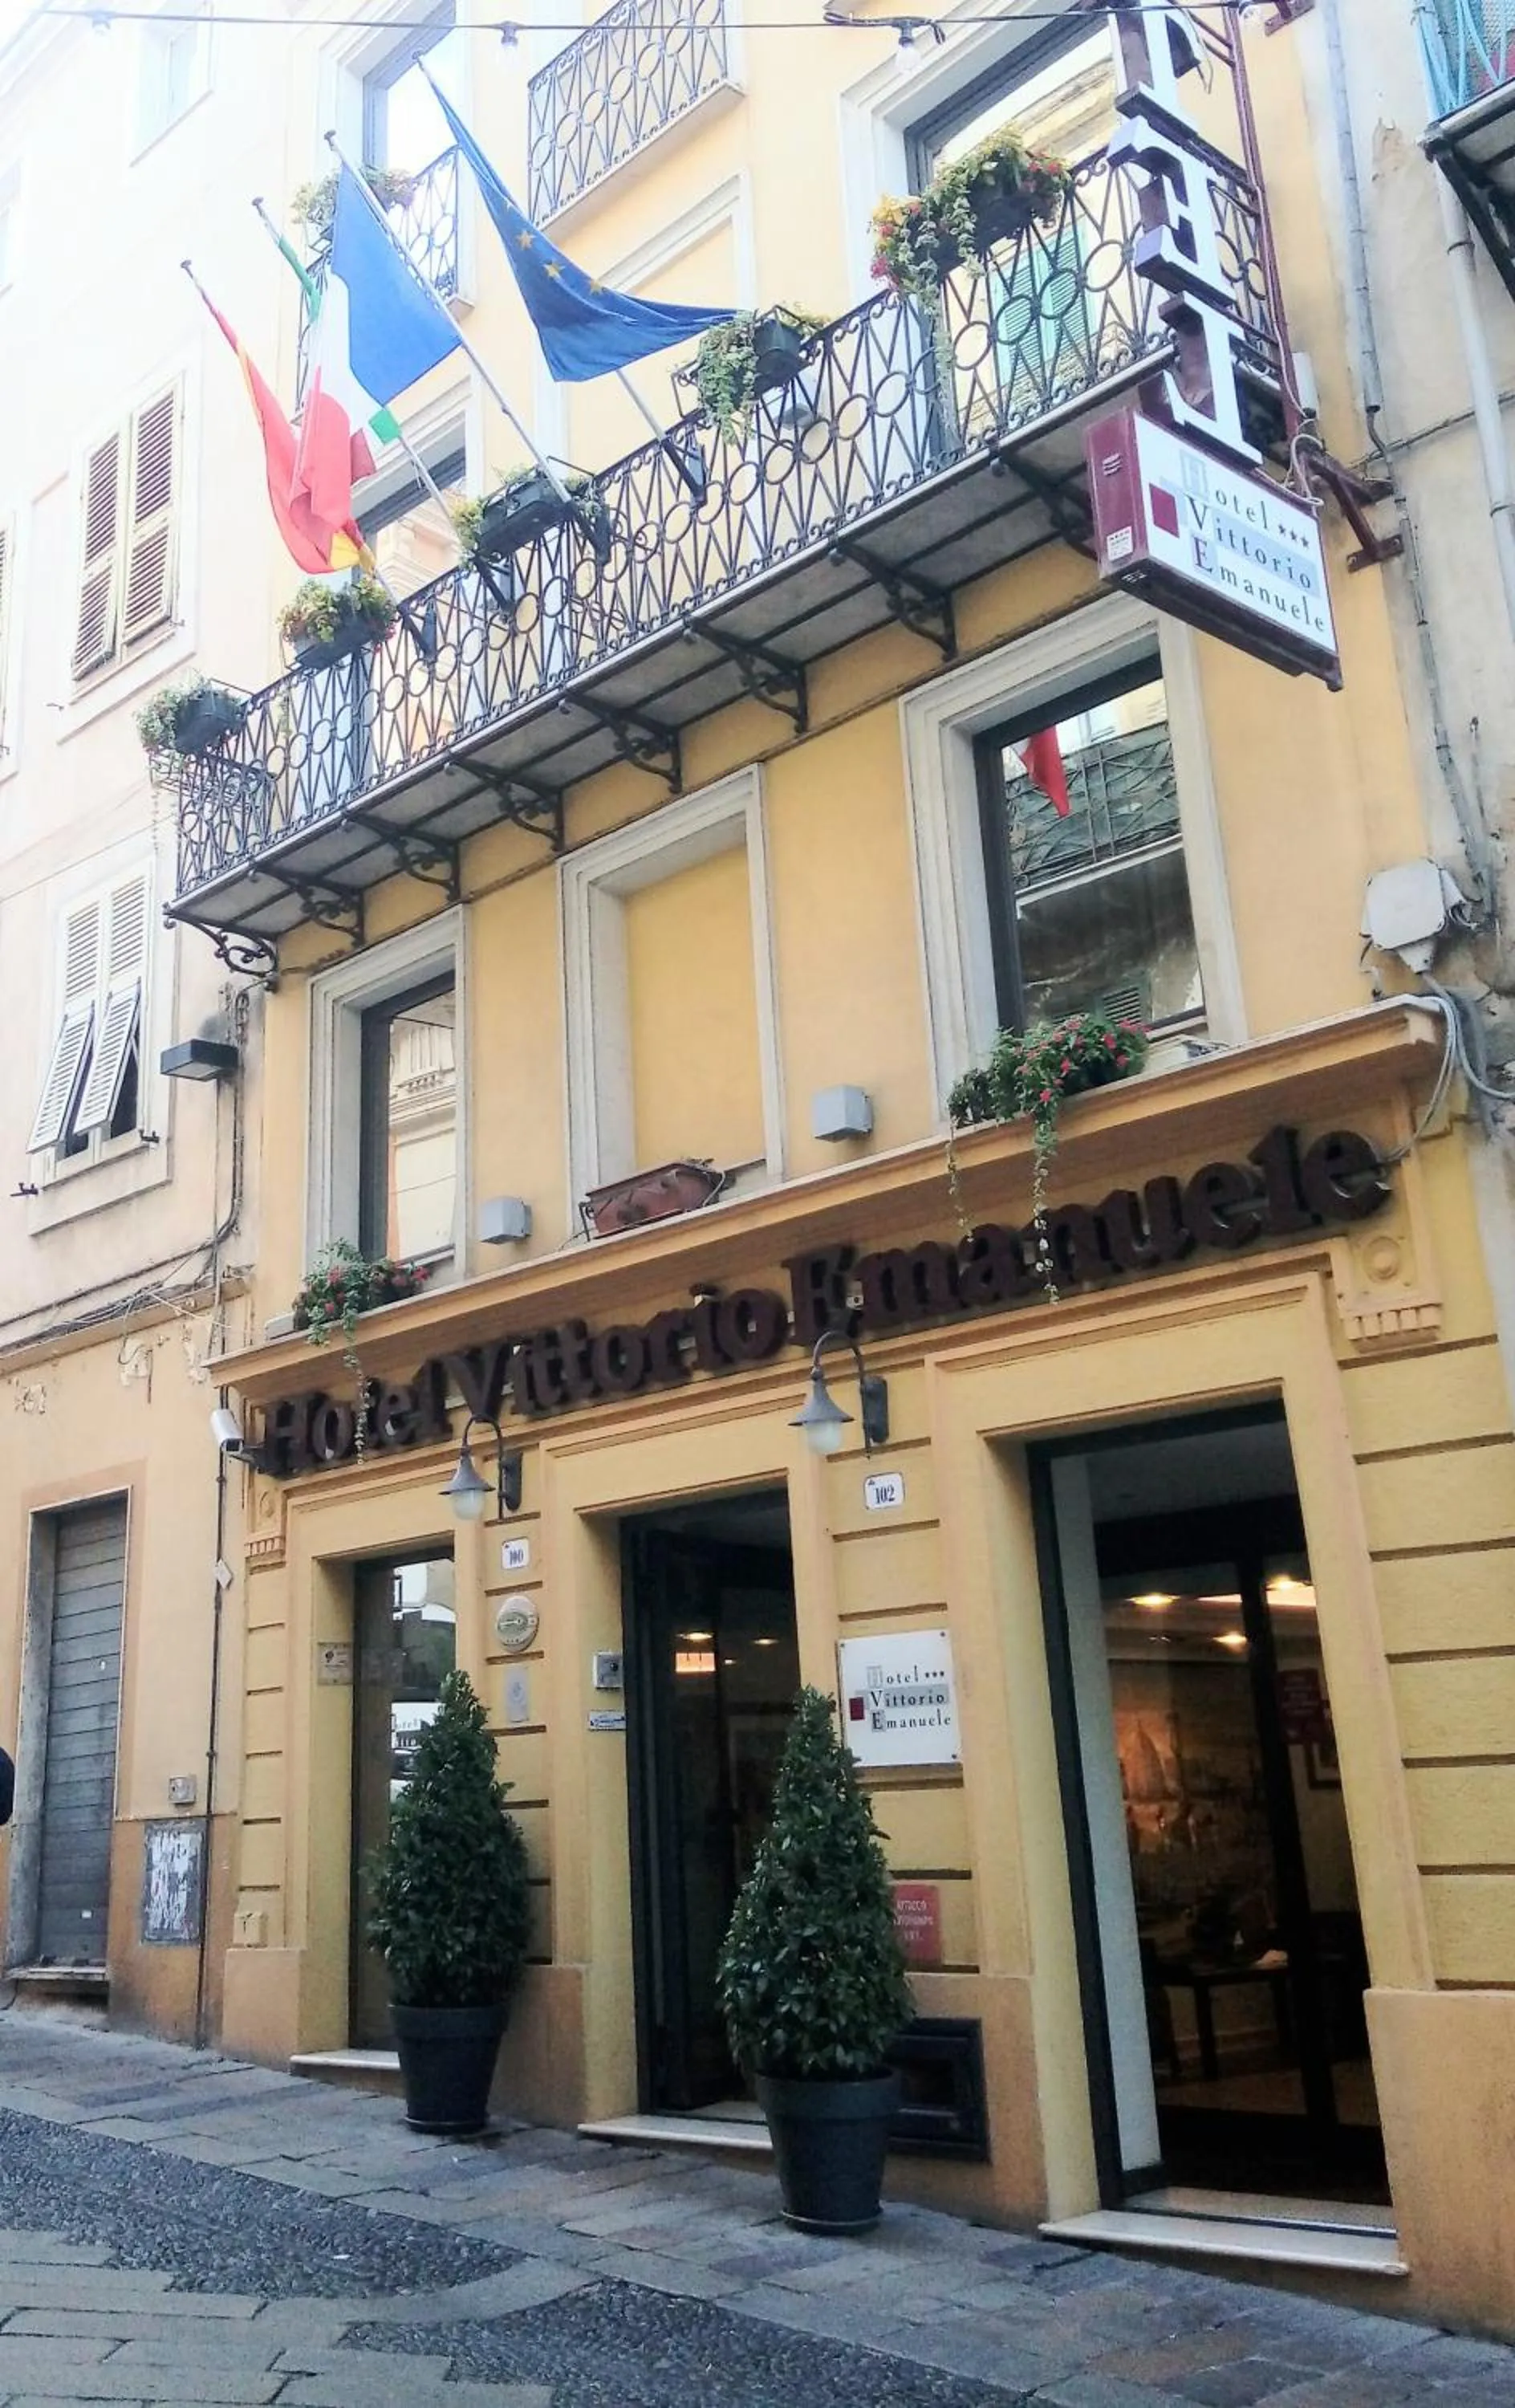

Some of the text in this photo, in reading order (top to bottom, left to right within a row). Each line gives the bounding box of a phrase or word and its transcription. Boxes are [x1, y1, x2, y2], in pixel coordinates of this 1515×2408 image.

[1185, 493, 1311, 590] Vittorio
[1193, 535, 1325, 633] Emanuele
[444, 1284, 790, 1422] Vittorio
[782, 1124, 1395, 1347] Emanuele
[875, 1484, 896, 1504] 102
[871, 1689, 944, 1707] Vittorio
[872, 1708, 951, 1730] Emanuele
